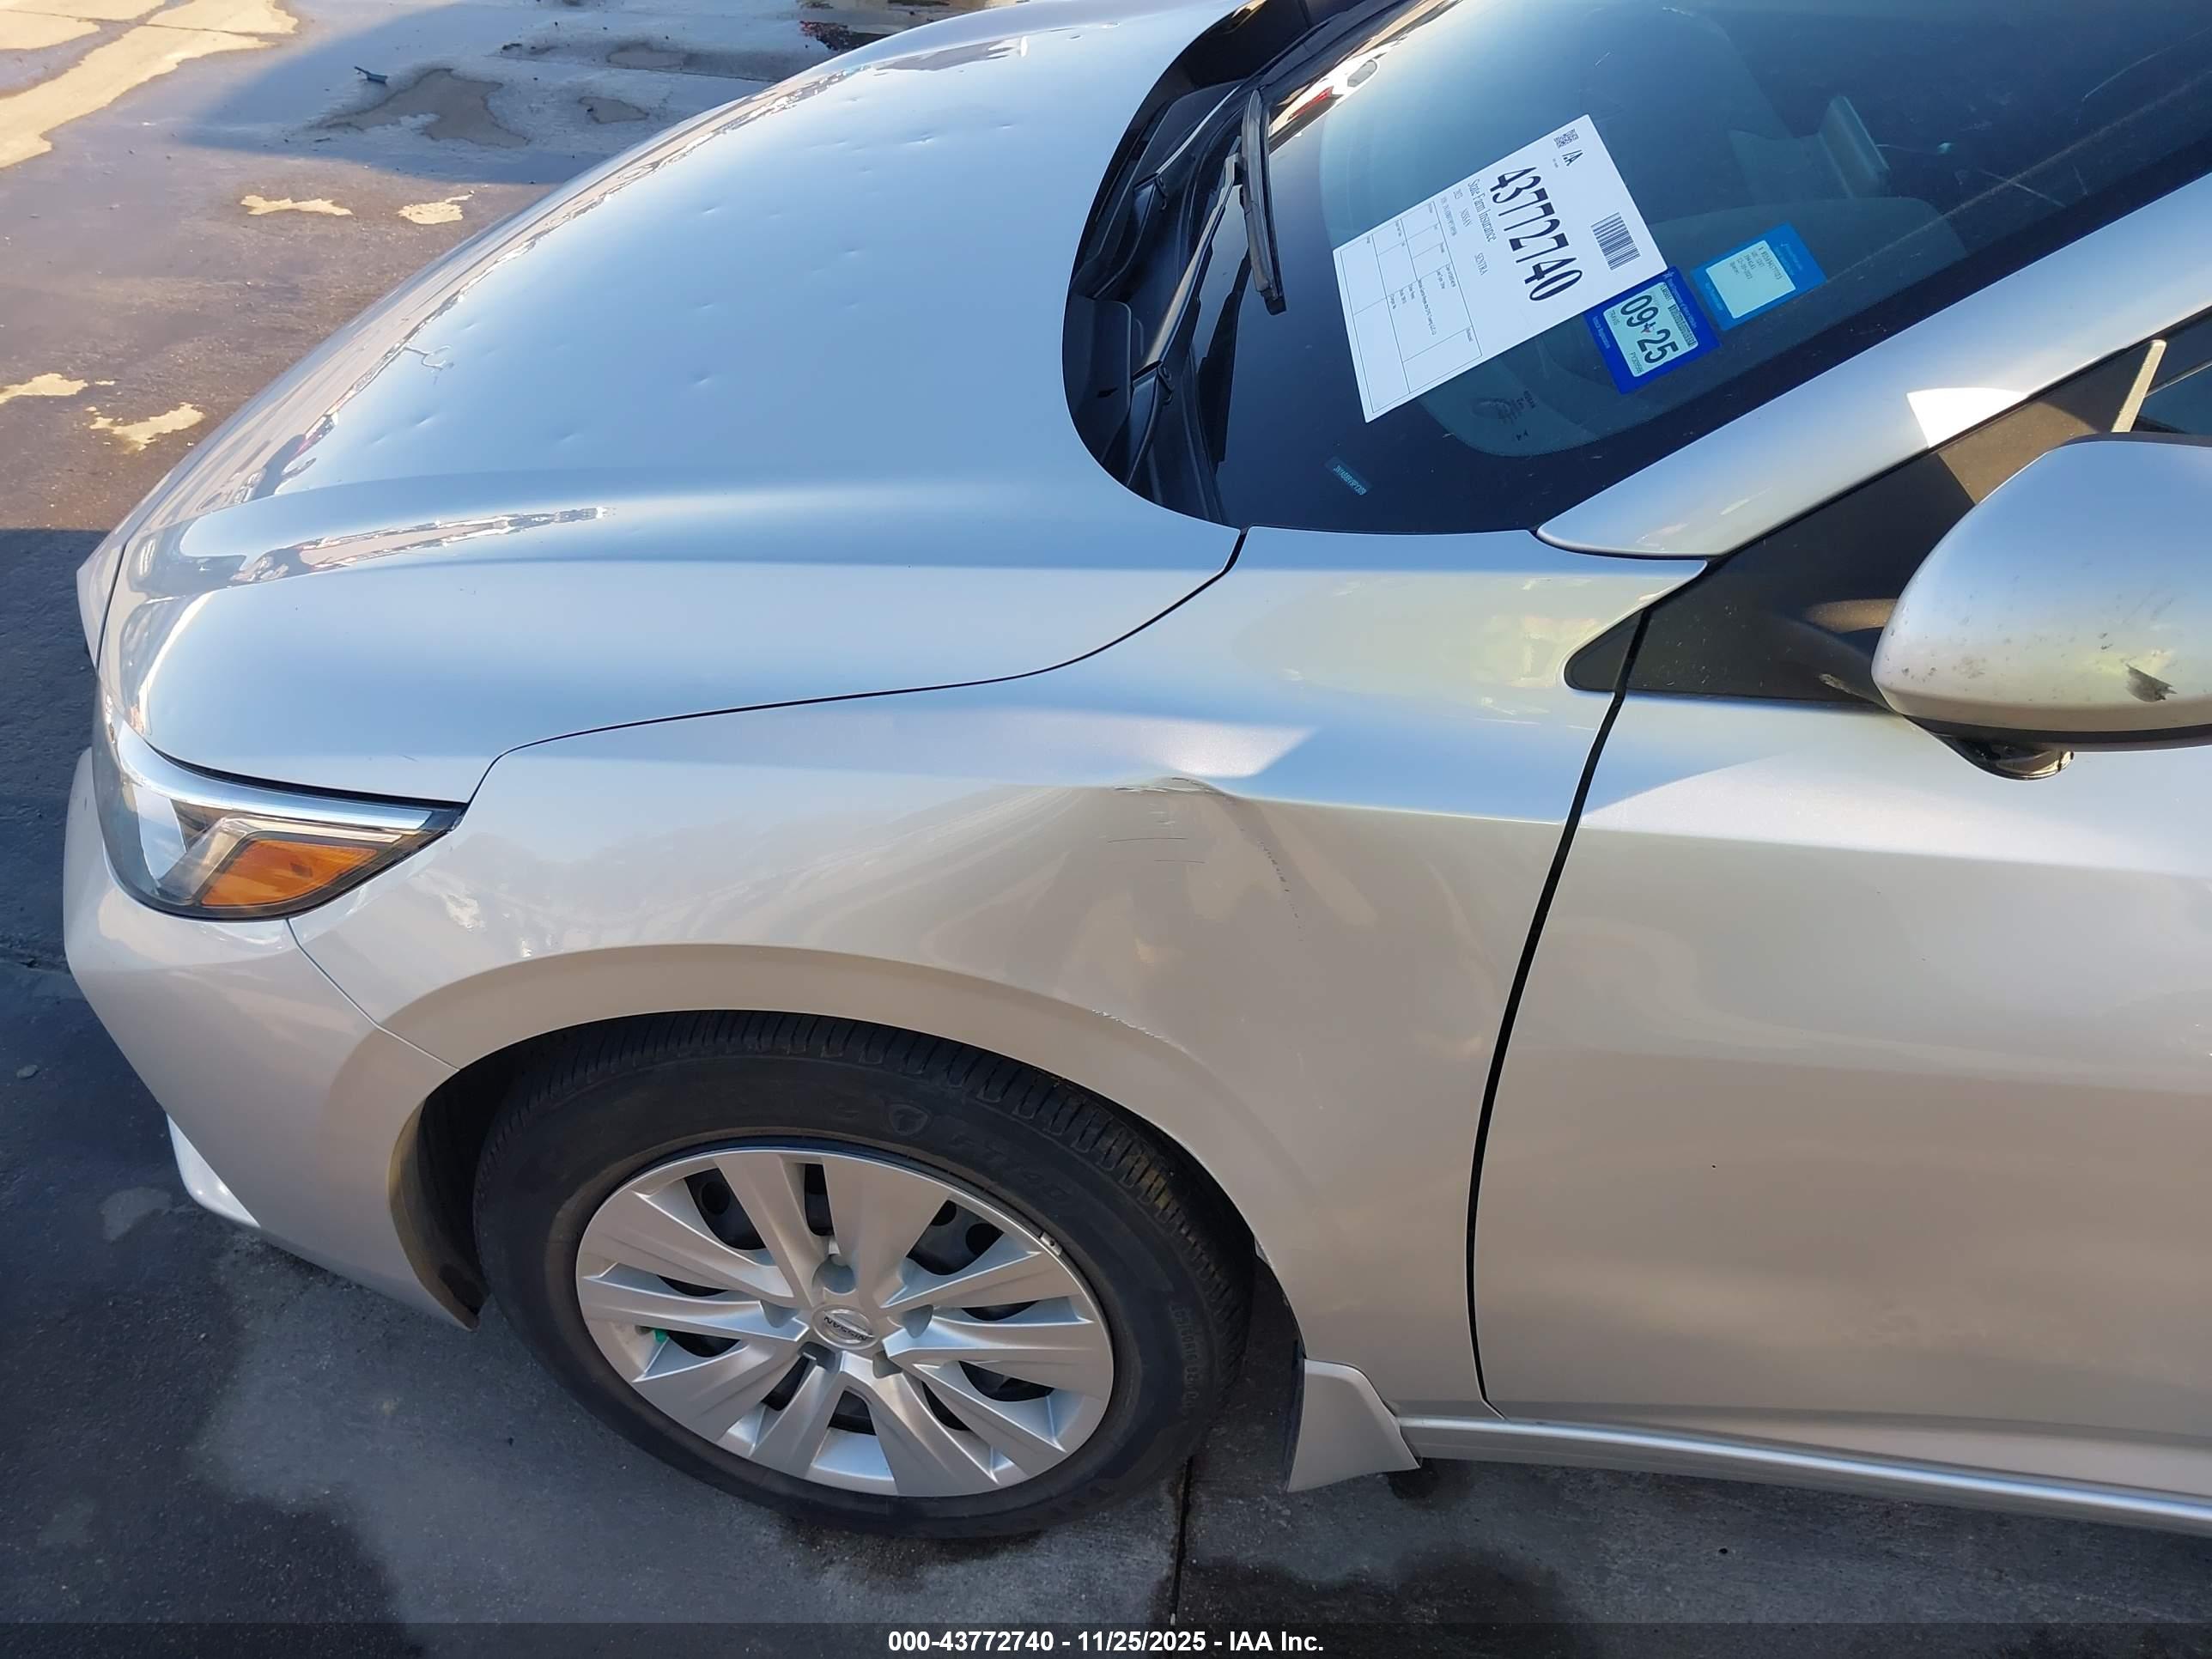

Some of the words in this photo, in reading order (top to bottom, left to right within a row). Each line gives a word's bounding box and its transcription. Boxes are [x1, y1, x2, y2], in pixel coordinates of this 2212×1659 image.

[1467, 178, 1483, 197] State
[1472, 191, 1489, 212] Farm
[1478, 208, 1498, 243] Insurance
[1490, 167, 1583, 301] 43772740
[1474, 252, 1488, 275] SENTRA
[1620, 294, 1659, 328] 09
[1637, 331, 1680, 365] 25
